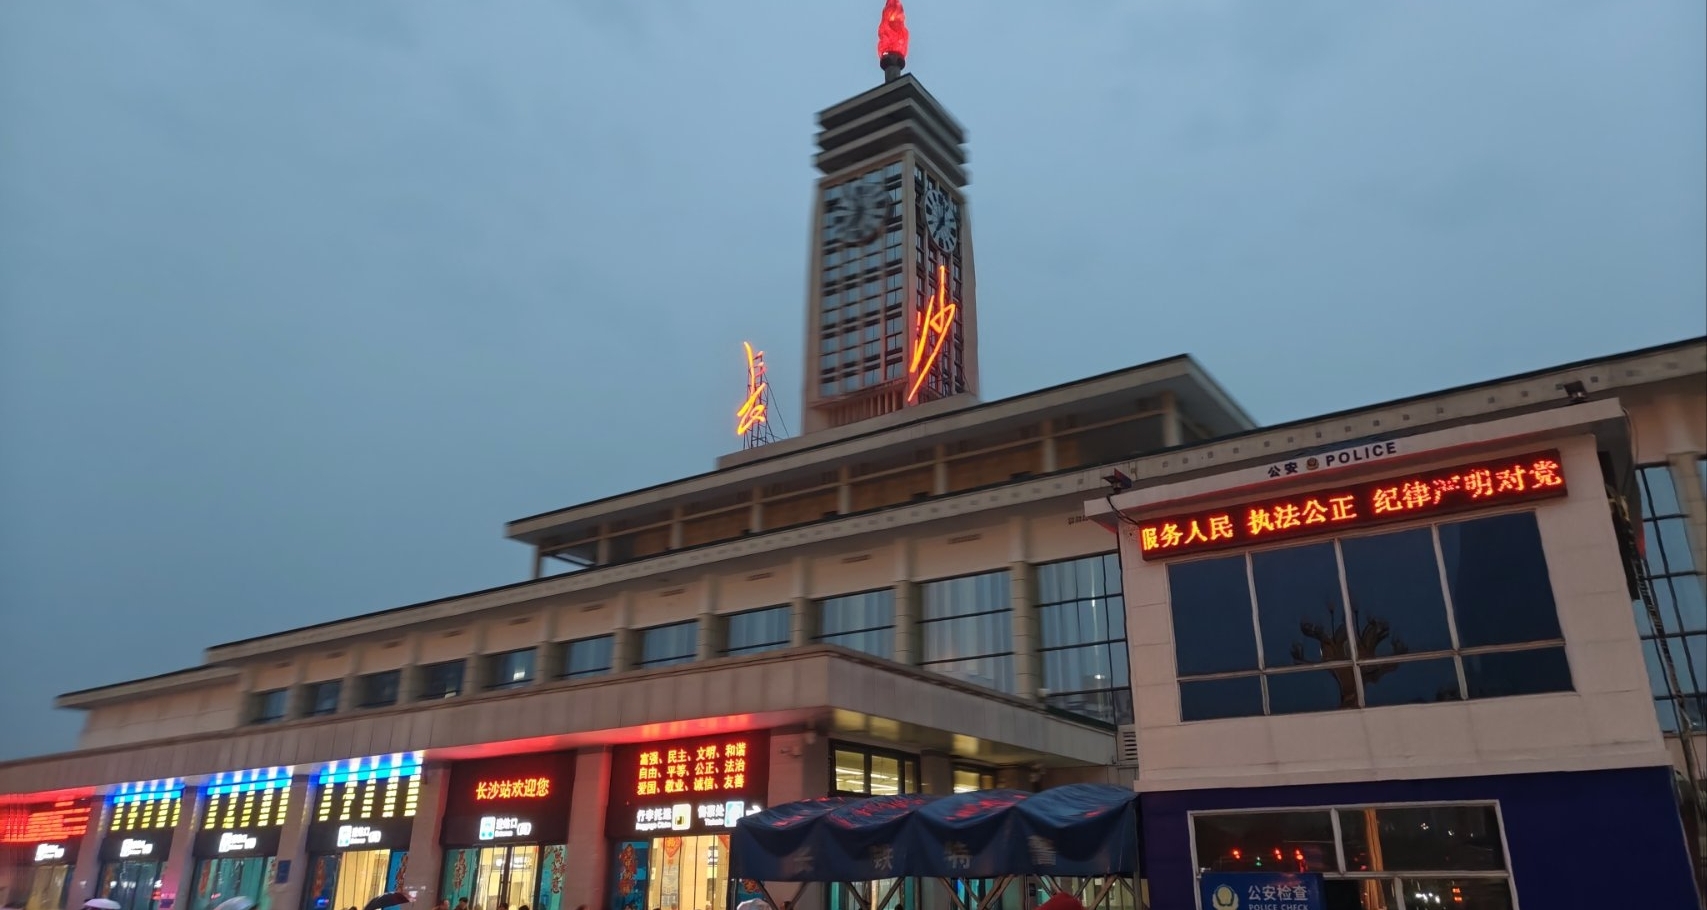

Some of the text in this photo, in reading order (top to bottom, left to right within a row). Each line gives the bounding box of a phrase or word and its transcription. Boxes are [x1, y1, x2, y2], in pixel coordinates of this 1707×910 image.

[908, 265, 956, 402] 沙
[1325, 442, 1397, 466] POLICE
[1267, 462, 1299, 478] 公安
[1142, 514, 1234, 551] 服务人民
[1248, 495, 1357, 535] 执法公正
[639, 742, 746, 766] 富强、民主、文明、和谐
[638, 758, 746, 780] 自由、平等、公正、法治
[476, 777, 550, 800] 长沙站欢迎您
[636, 774, 745, 796] 爱国、敬业、诚信、友善
[1248, 885, 1308, 901] 公安检查
